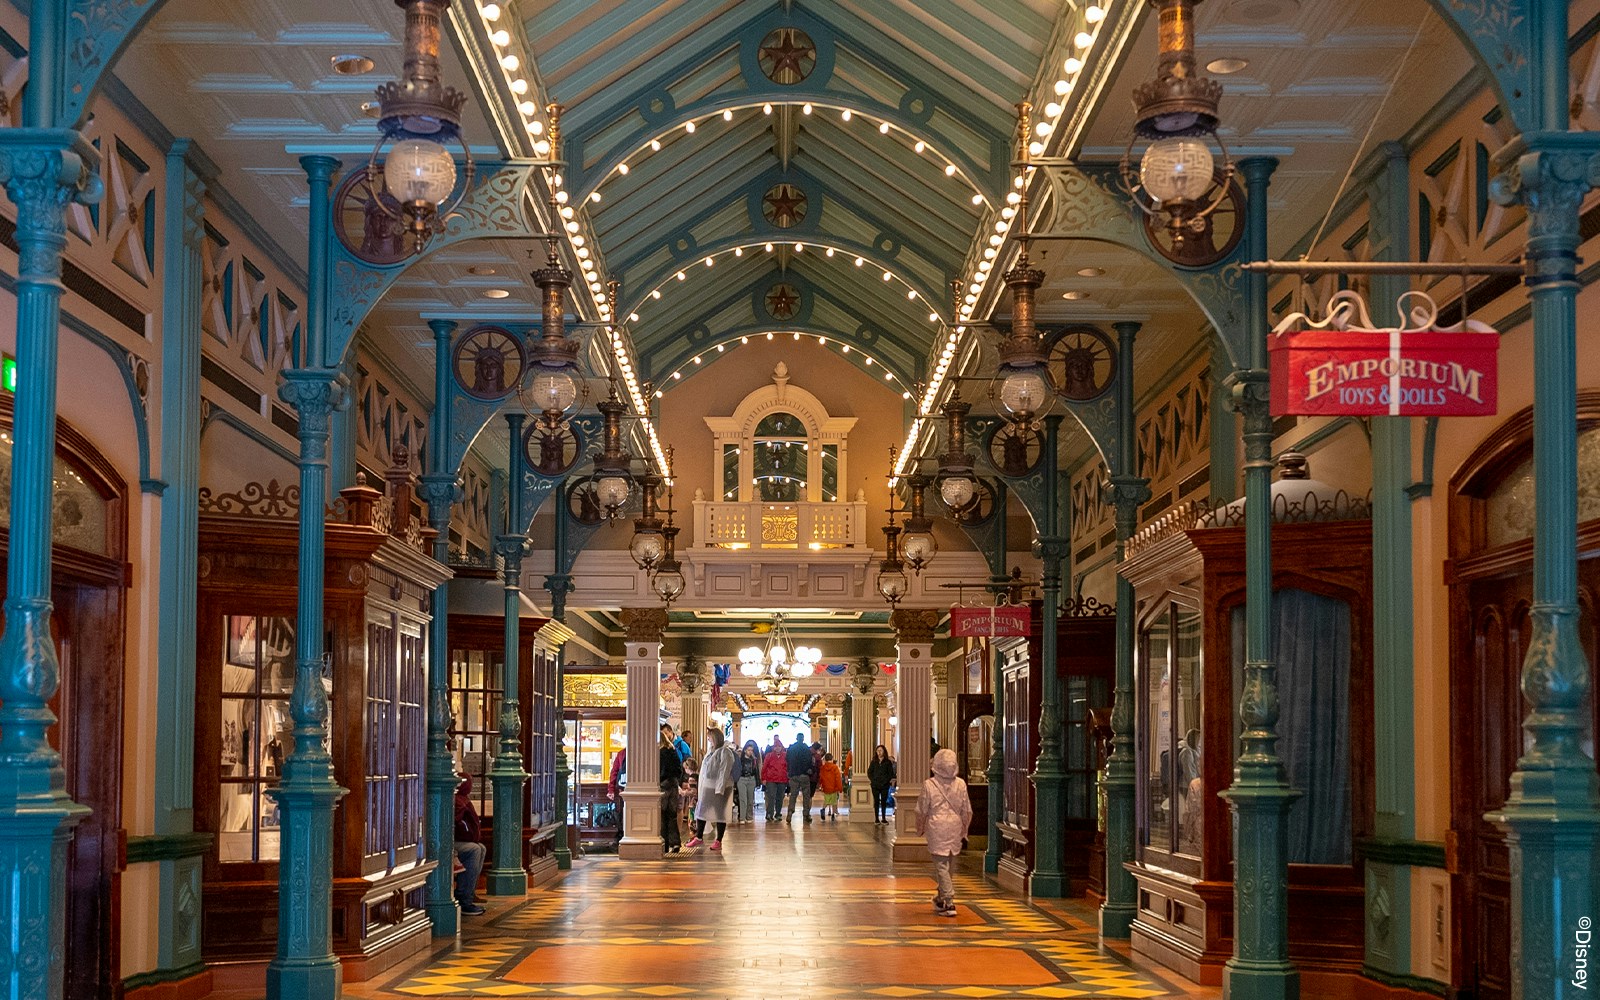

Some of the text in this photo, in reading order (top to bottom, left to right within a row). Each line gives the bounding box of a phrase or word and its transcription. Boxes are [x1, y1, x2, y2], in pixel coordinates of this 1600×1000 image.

[1305, 358, 1485, 405] EMPORIUM
[1379, 384, 1391, 405] &
[1398, 387, 1447, 405] DOLLS
[962, 616, 1024, 631] EMPORIUM
